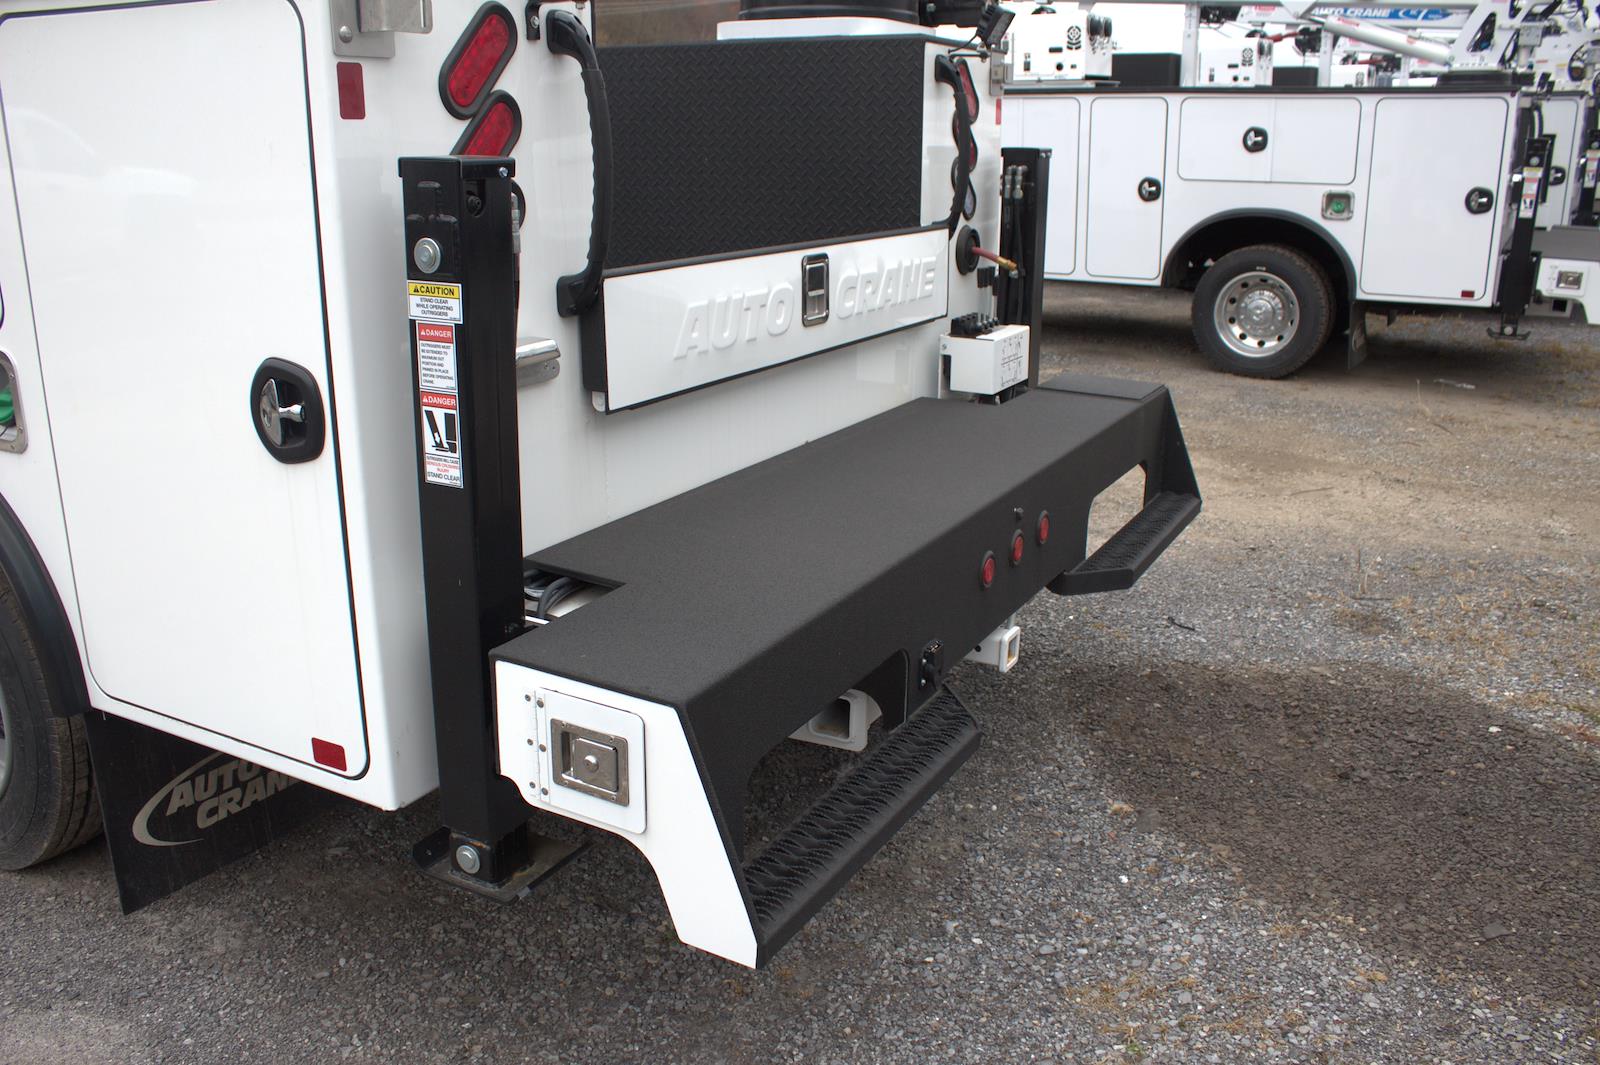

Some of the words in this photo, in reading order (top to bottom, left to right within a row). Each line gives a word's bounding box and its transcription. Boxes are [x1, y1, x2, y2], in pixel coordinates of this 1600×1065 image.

[1311, 7, 1344, 16] AUTO
[1346, 7, 1391, 17] CRANE
[420, 285, 455, 296] CAUTION
[421, 309, 448, 317] OUTRIGGERS
[673, 281, 795, 360] AUTO
[835, 256, 937, 319] CRANE
[425, 329, 452, 338] DANGER
[428, 396, 456, 406] DANGER
[427, 471, 443, 479] STAND
[443, 474, 460, 482] CLEAR
[166, 759, 261, 816] AUTO
